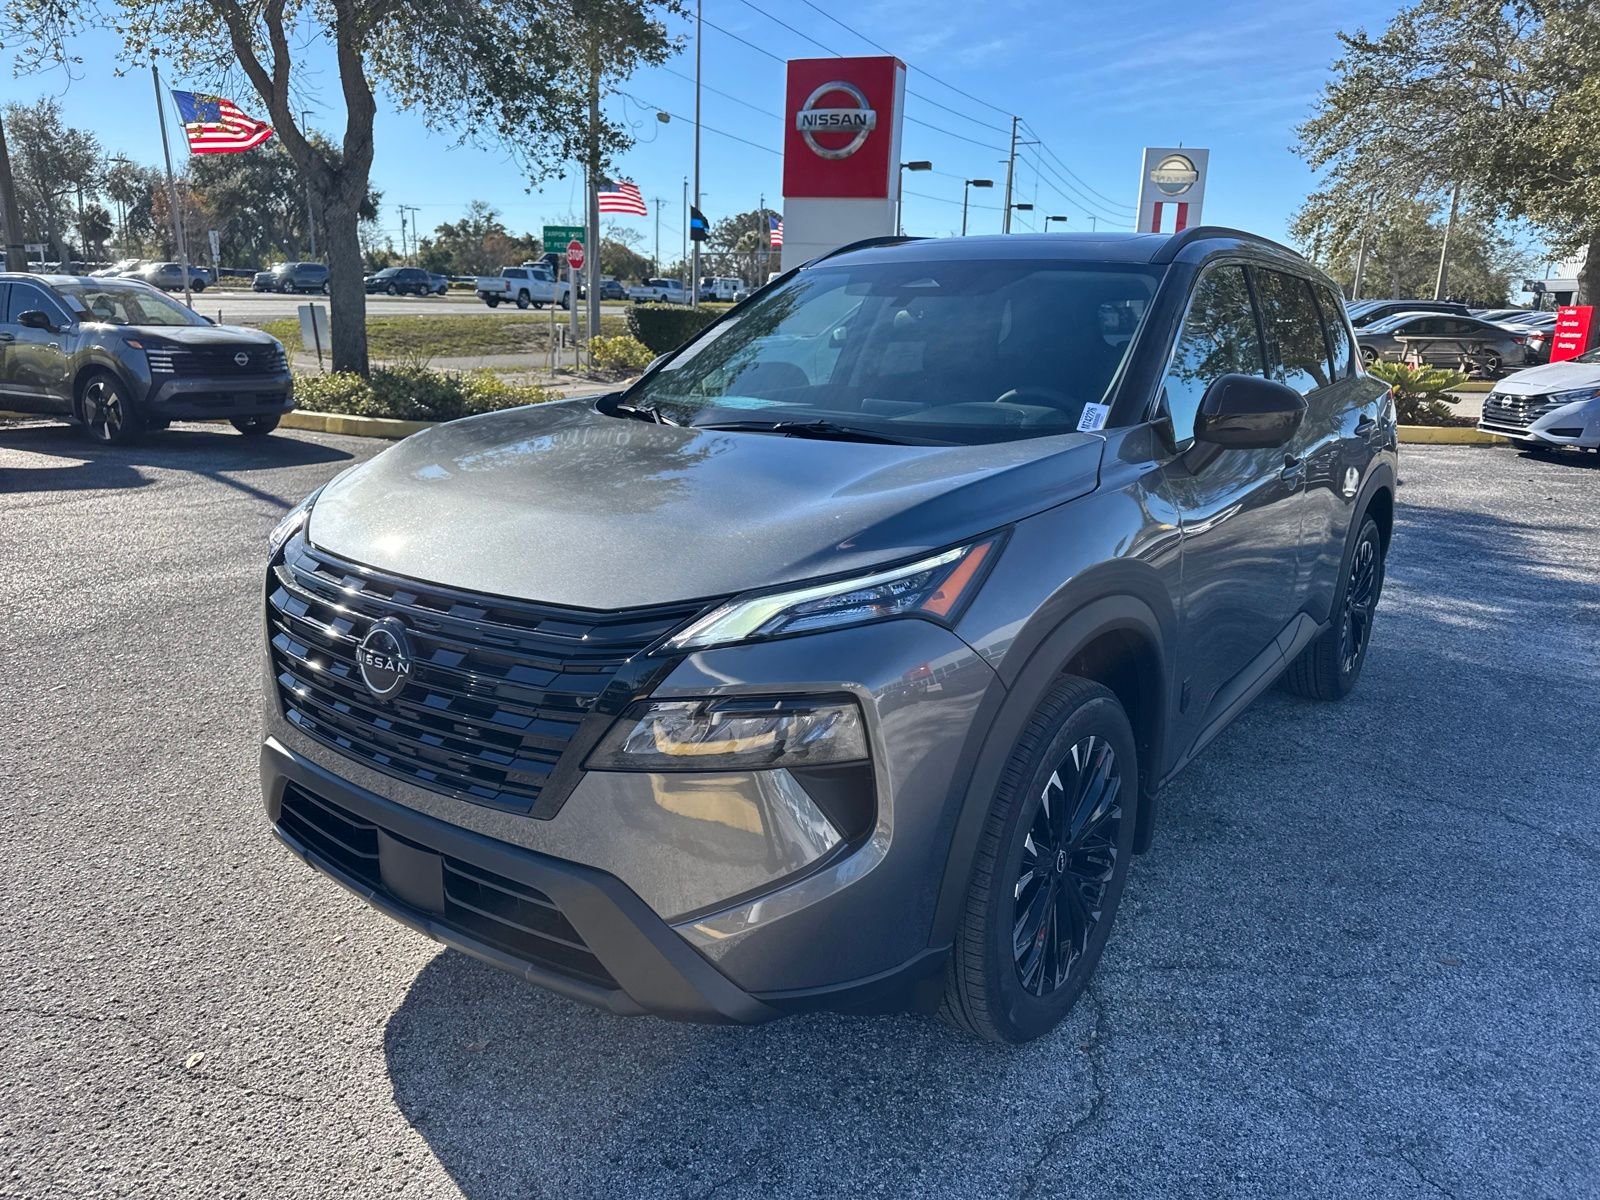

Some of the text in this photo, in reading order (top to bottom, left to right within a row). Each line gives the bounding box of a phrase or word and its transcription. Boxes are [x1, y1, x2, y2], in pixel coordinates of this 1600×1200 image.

[802, 113, 867, 126] NISSAN
[568, 249, 584, 261] STOP
[356, 645, 410, 673] NISSAN
